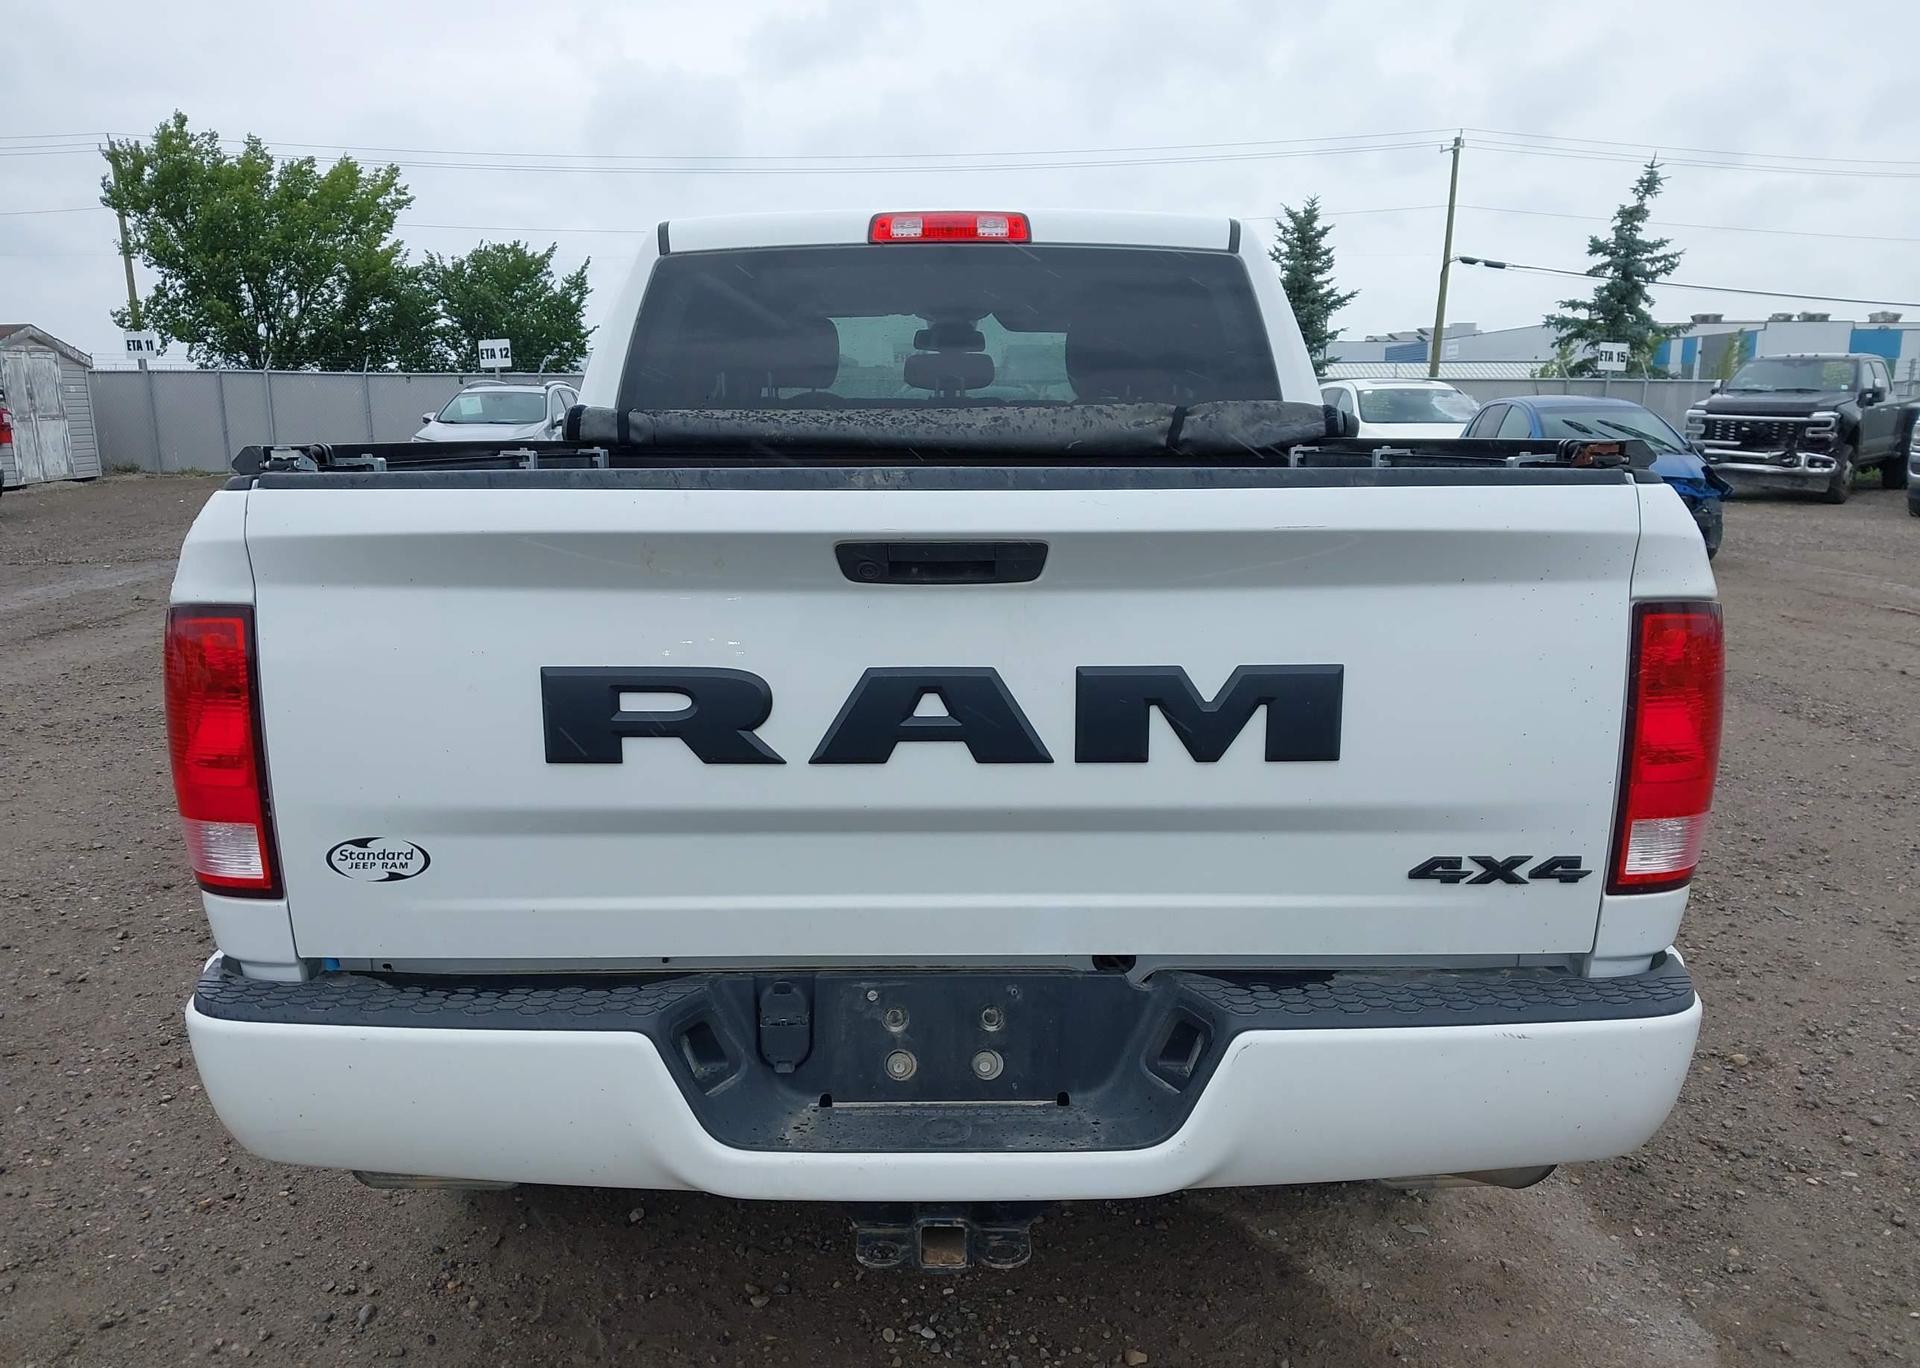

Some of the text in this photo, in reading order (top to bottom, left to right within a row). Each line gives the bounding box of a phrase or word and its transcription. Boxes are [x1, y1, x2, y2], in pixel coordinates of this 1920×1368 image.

[127, 339, 154, 351] ETA 11
[480, 347, 510, 359] ETA 12
[1599, 350, 1627, 363] ETA 15
[540, 664, 1345, 765] RAM
[336, 848, 414, 862] Standard
[348, 862, 409, 870] JEEP RAM
[1408, 855, 1593, 885] 4X4
